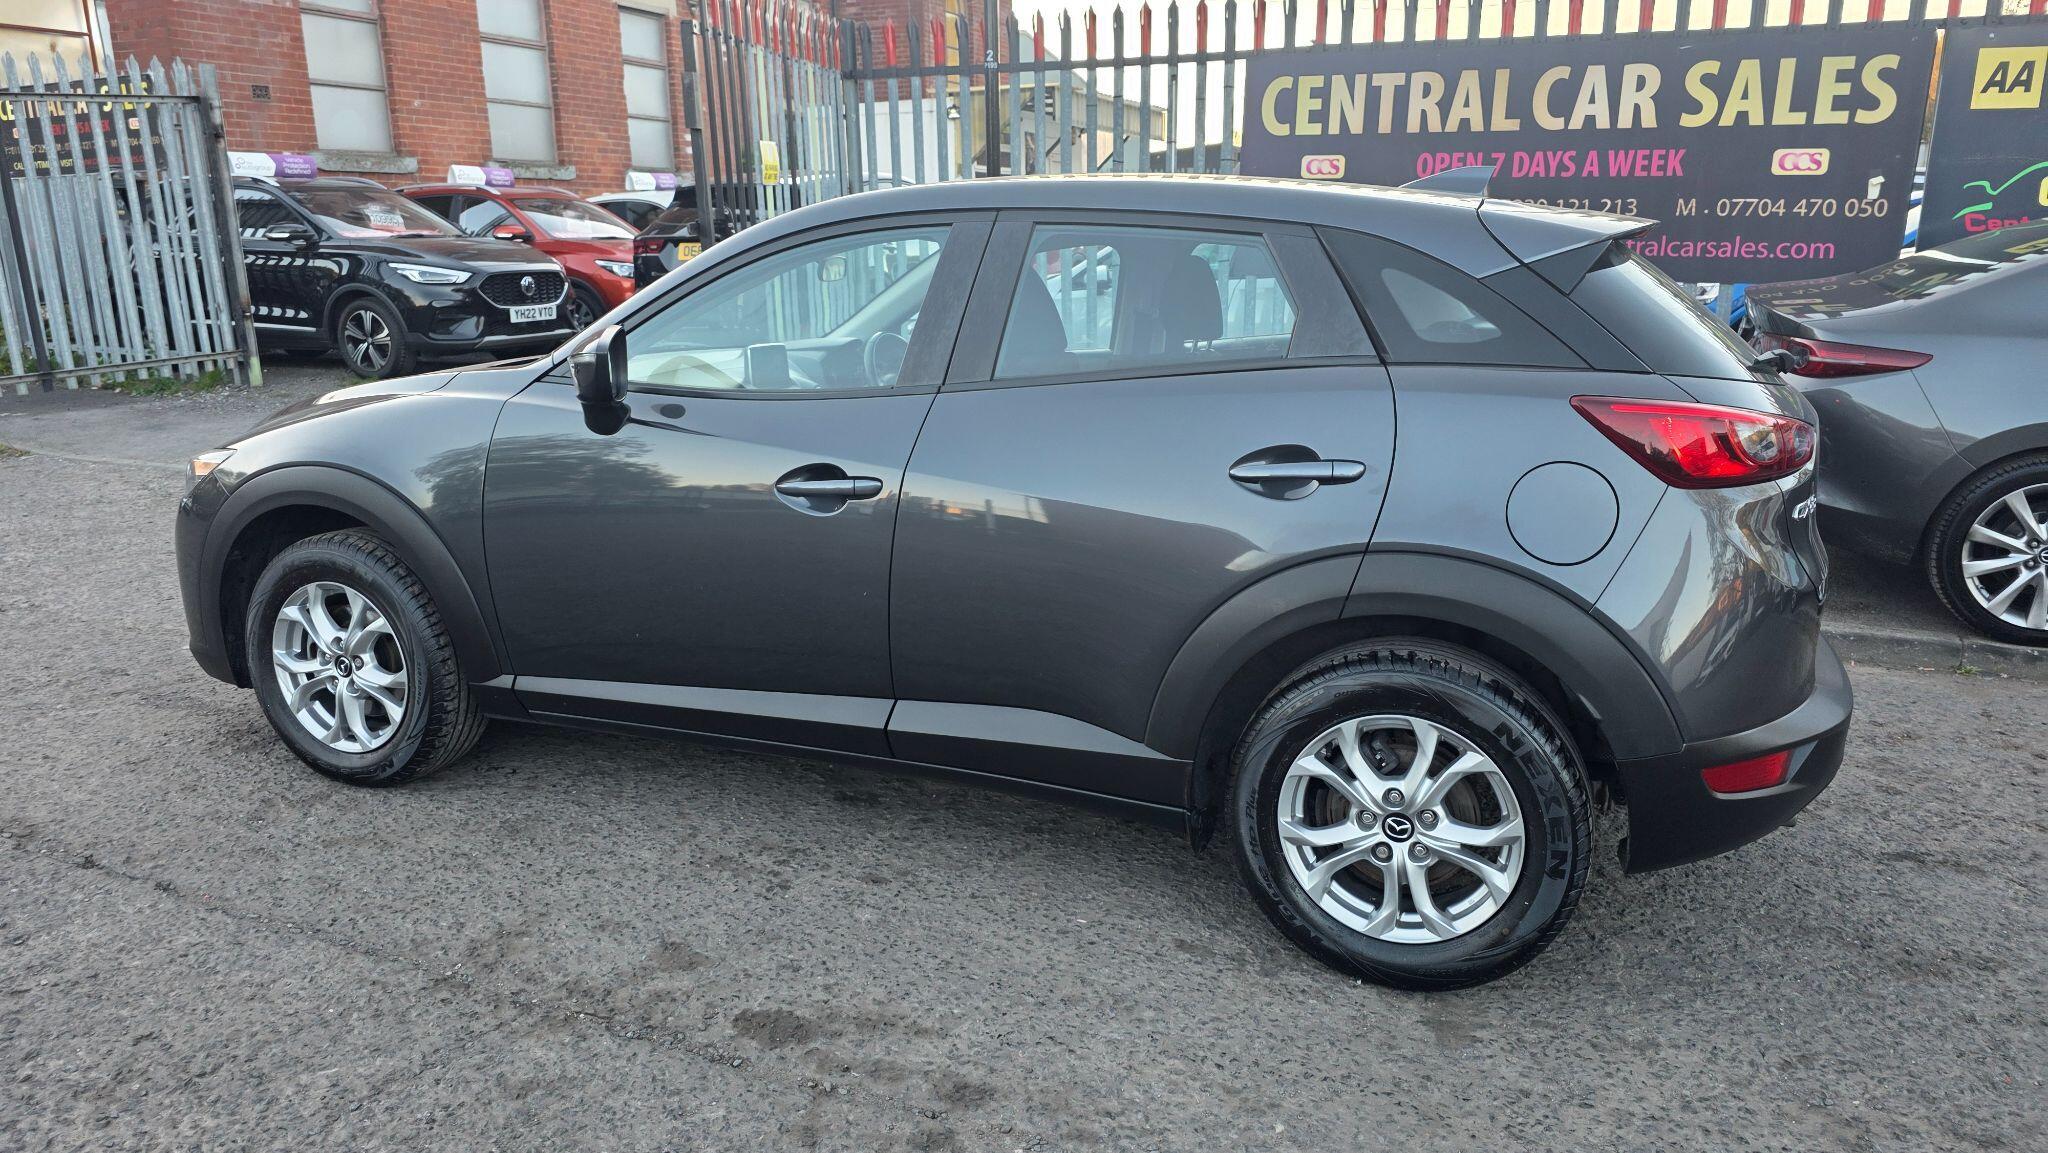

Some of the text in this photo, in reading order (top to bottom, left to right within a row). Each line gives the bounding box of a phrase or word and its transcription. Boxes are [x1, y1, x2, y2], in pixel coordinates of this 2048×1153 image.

[986, 49, 994, 62] 2
[1980, 60, 2037, 94] AA
[1260, 53, 1901, 137] CENTRAL CAR SALES
[1416, 149, 1687, 179] OPEN 7 DAYS A WEEK
[1599, 197, 1638, 216] 213
[1675, 198, 1889, 217] M 07704 470 050
[1625, 235, 1836, 259] tralcarsales.com
[514, 308, 537, 320] YH22
[1492, 720, 1570, 880] NEXEN
